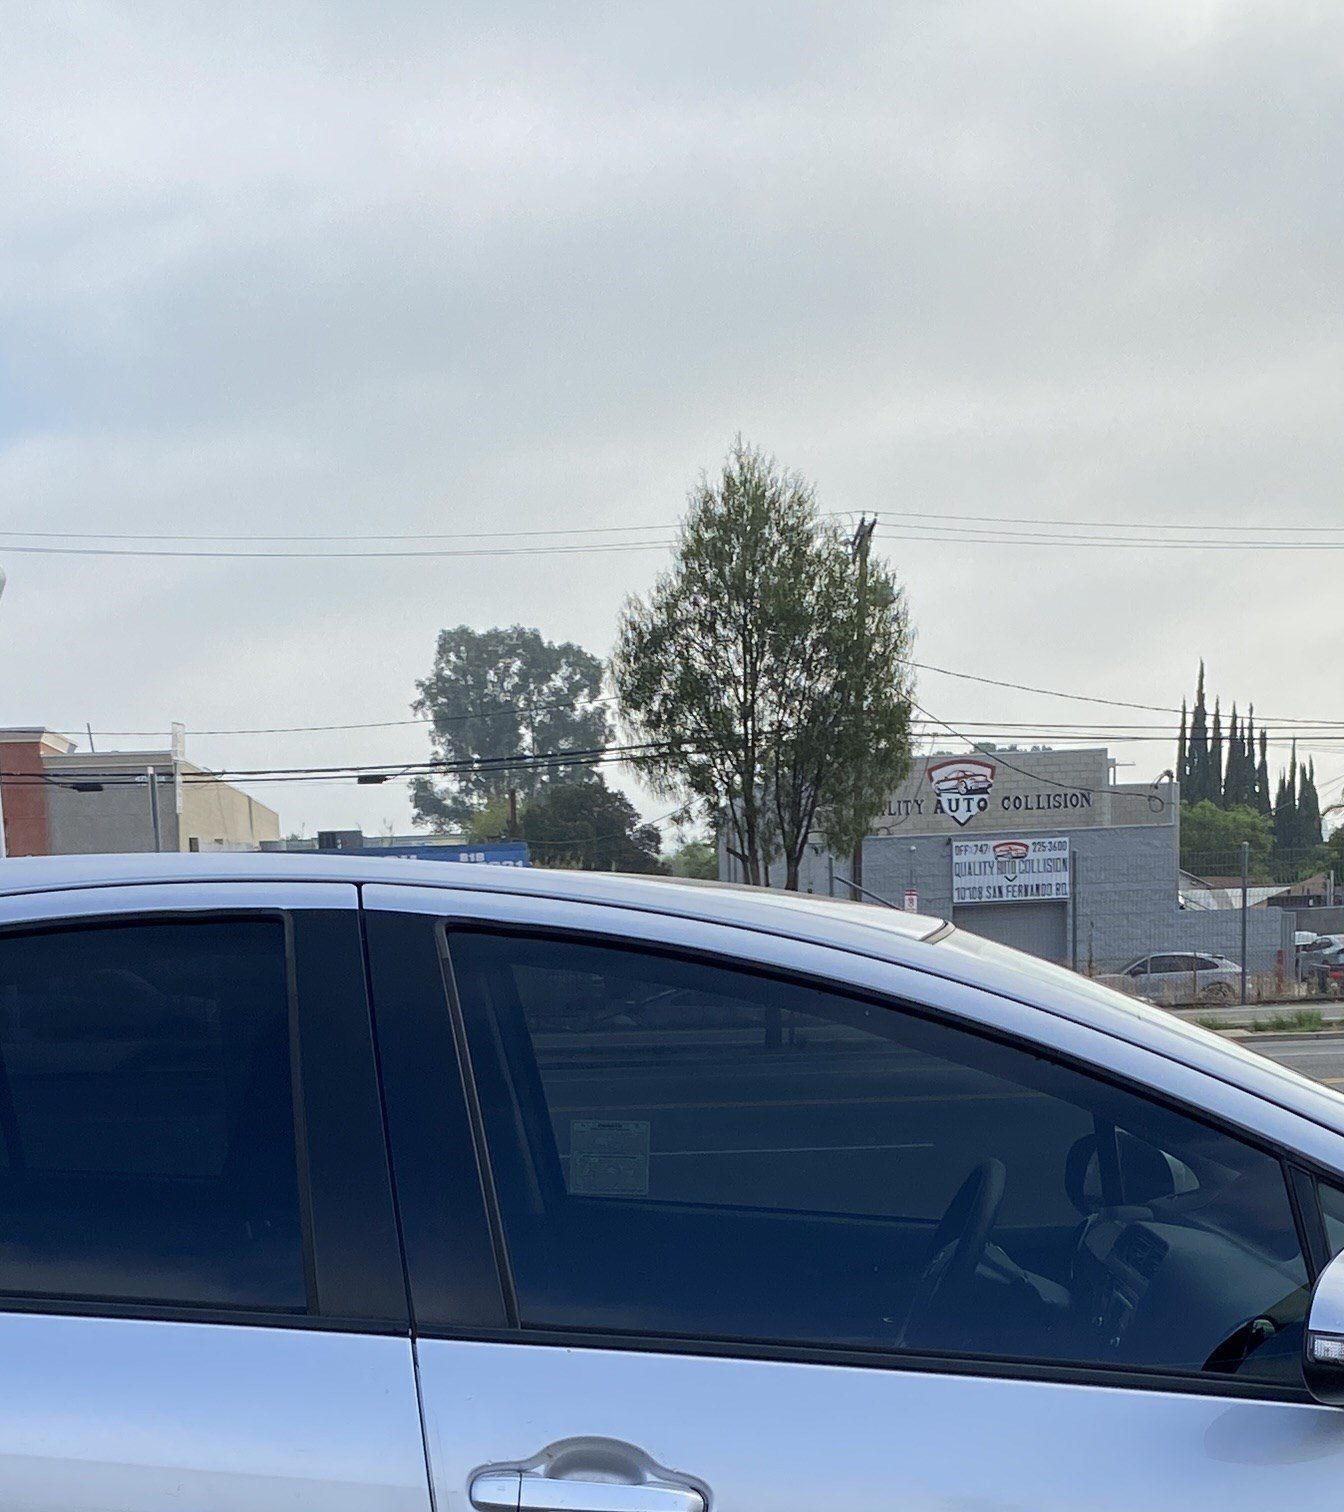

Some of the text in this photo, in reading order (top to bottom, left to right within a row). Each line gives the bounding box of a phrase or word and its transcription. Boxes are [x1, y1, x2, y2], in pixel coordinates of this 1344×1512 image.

[880, 791, 1093, 816] LITY AUTO COLLISION
[954, 861, 995, 878] QUALITY
[1018, 858, 1068, 874] COLLISION
[985, 884, 1003, 899] SAN
[1006, 883, 1053, 899] FERNANDO
